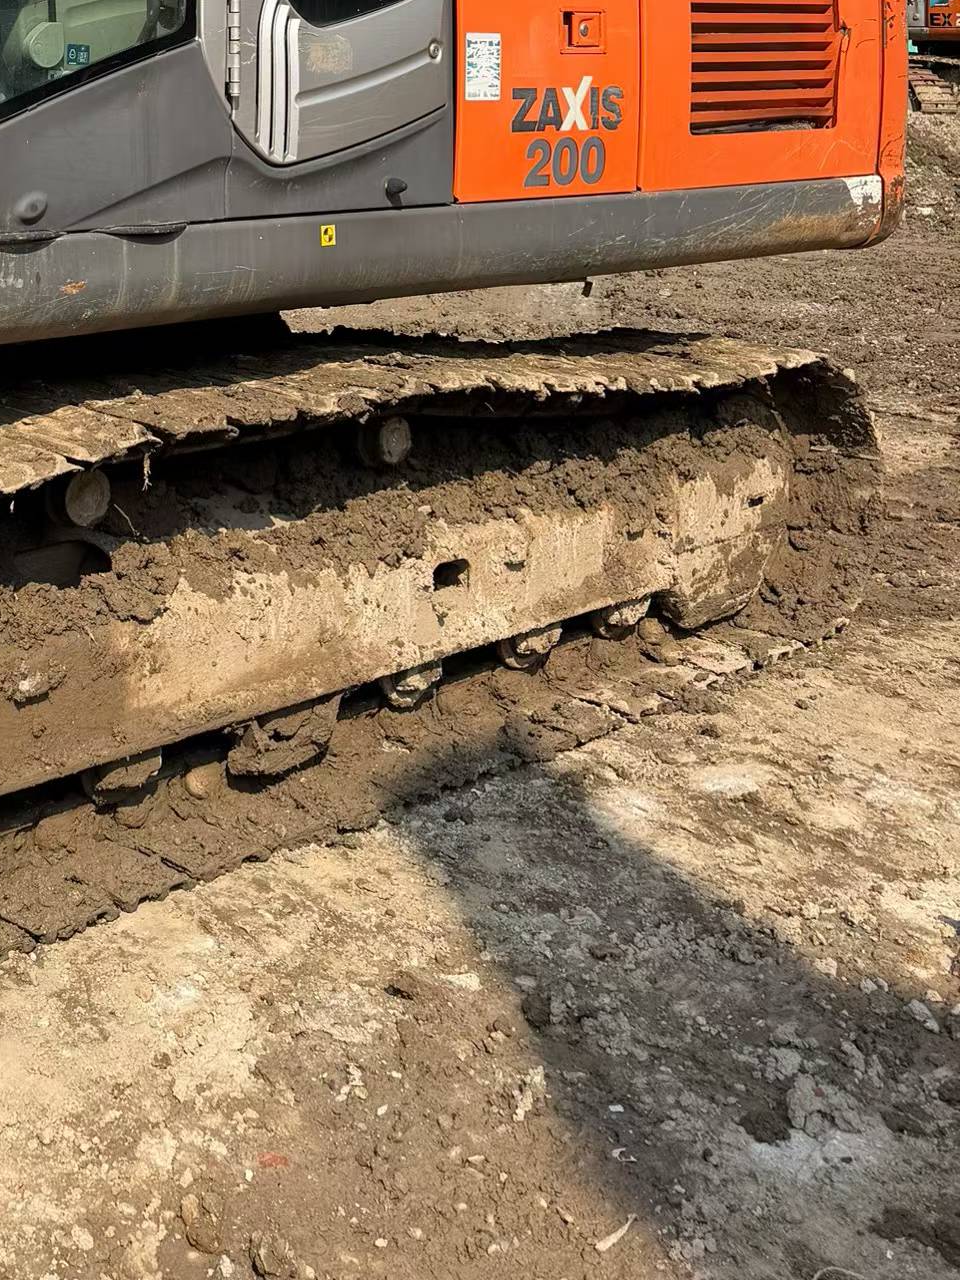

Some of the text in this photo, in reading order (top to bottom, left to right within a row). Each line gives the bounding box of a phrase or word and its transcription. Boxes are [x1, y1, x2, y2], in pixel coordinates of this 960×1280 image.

[929, 13, 952, 27] EX
[511, 76, 624, 133] ZAXIS
[523, 136, 606, 188] 200
